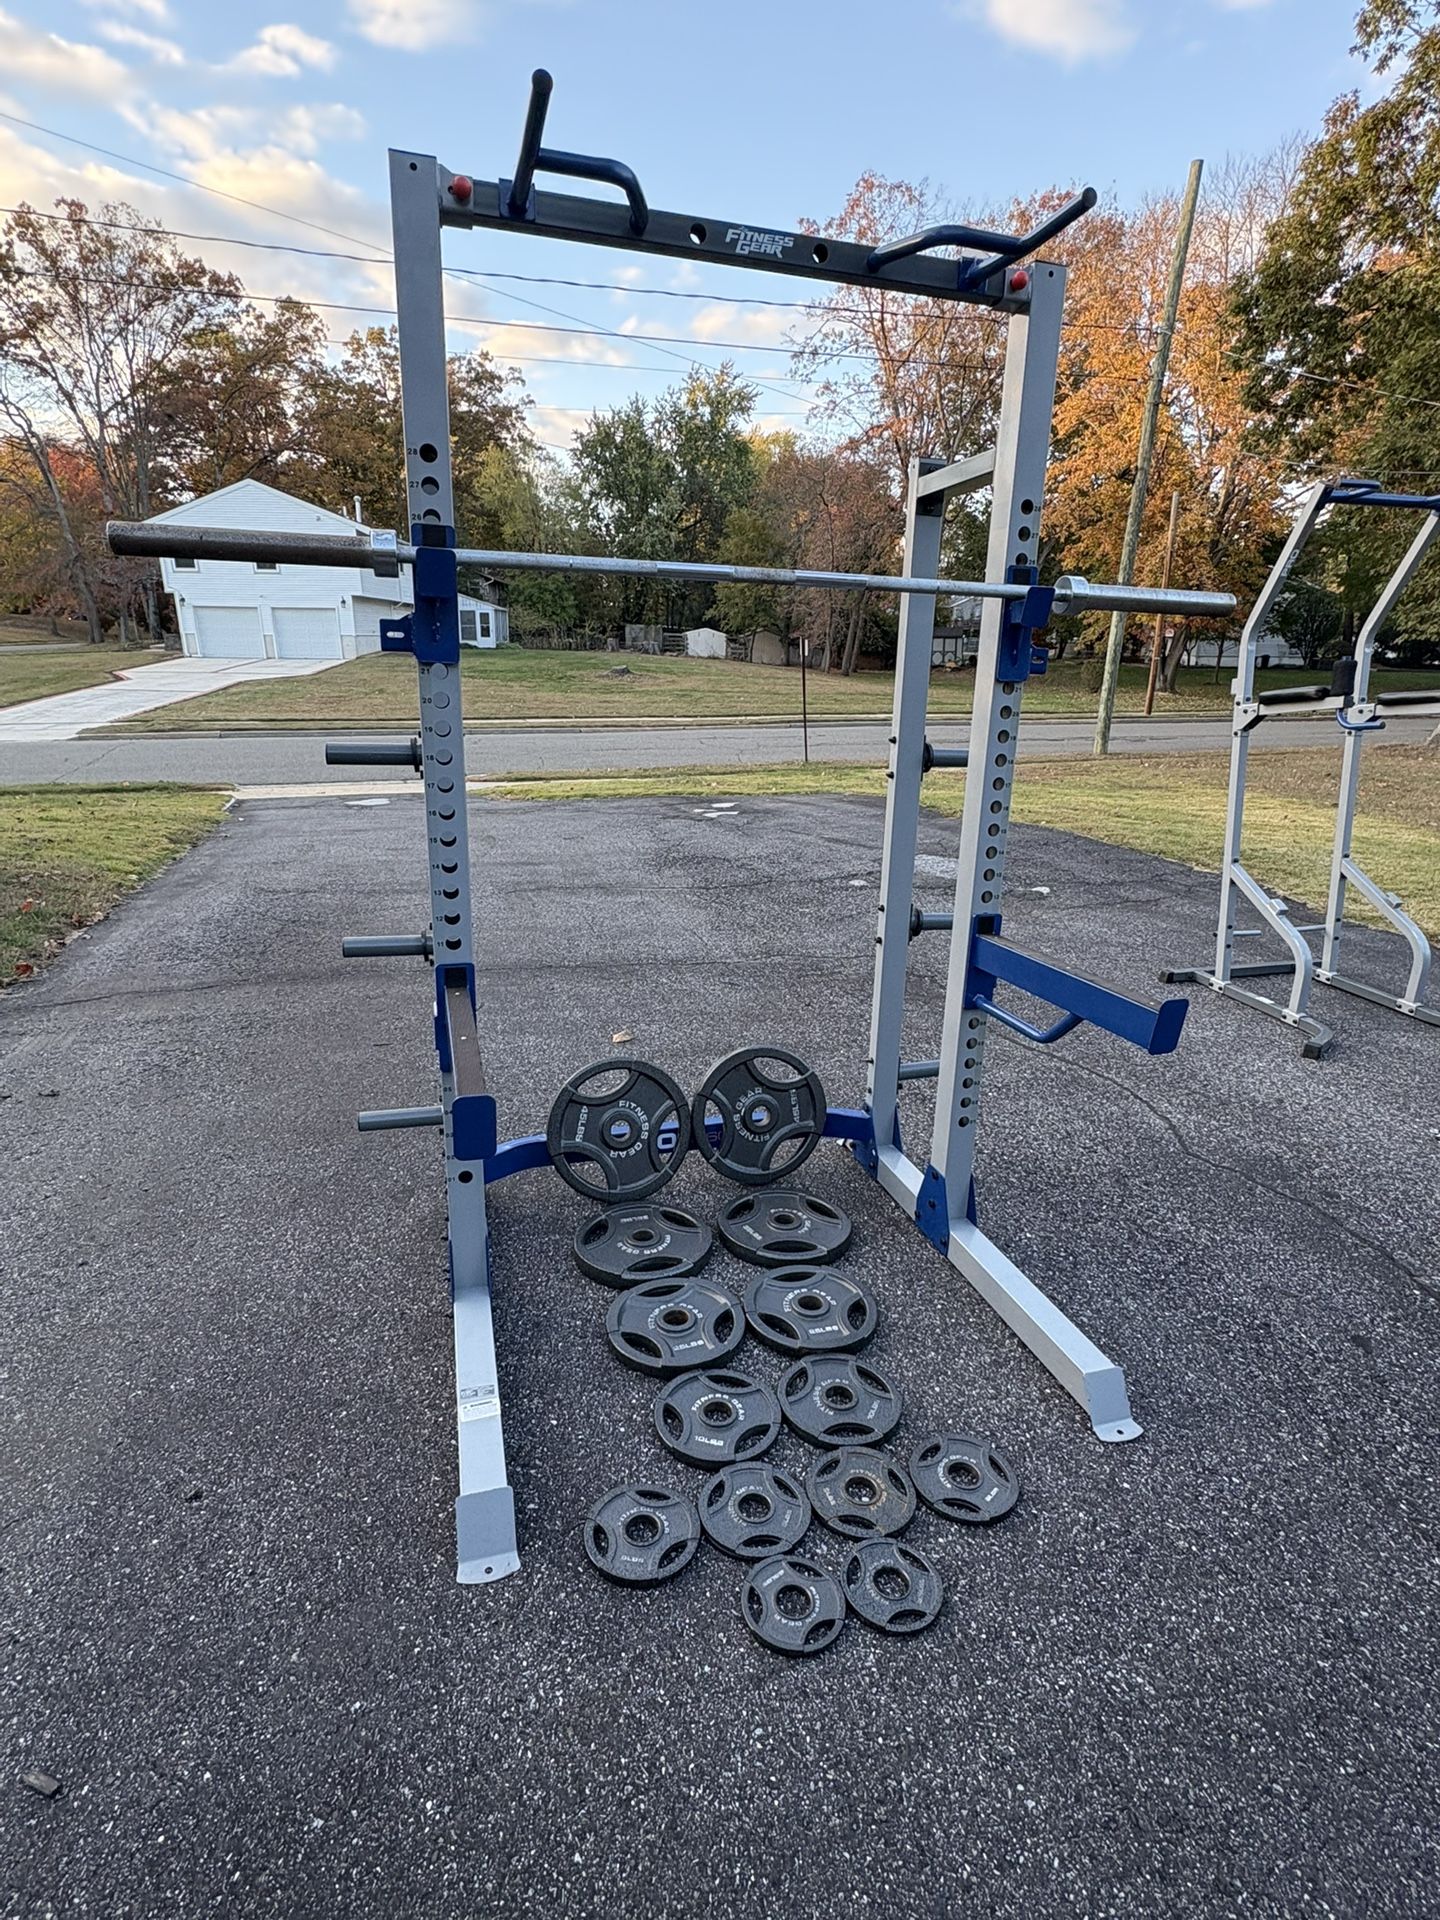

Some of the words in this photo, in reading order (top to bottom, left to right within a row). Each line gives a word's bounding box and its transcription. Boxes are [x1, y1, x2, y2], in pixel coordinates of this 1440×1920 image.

[725, 227, 794, 248] FITNESS
[736, 240, 782, 259] GEAR
[1280, 549, 1300, 577] PRO
[735, 1087, 763, 1111] GEAR
[575, 1105, 589, 1142] 45LBS
[618, 1100, 650, 1140] FITNESS
[733, 1113, 770, 1142] FITNESS
[609, 1142, 643, 1159] GEAR
